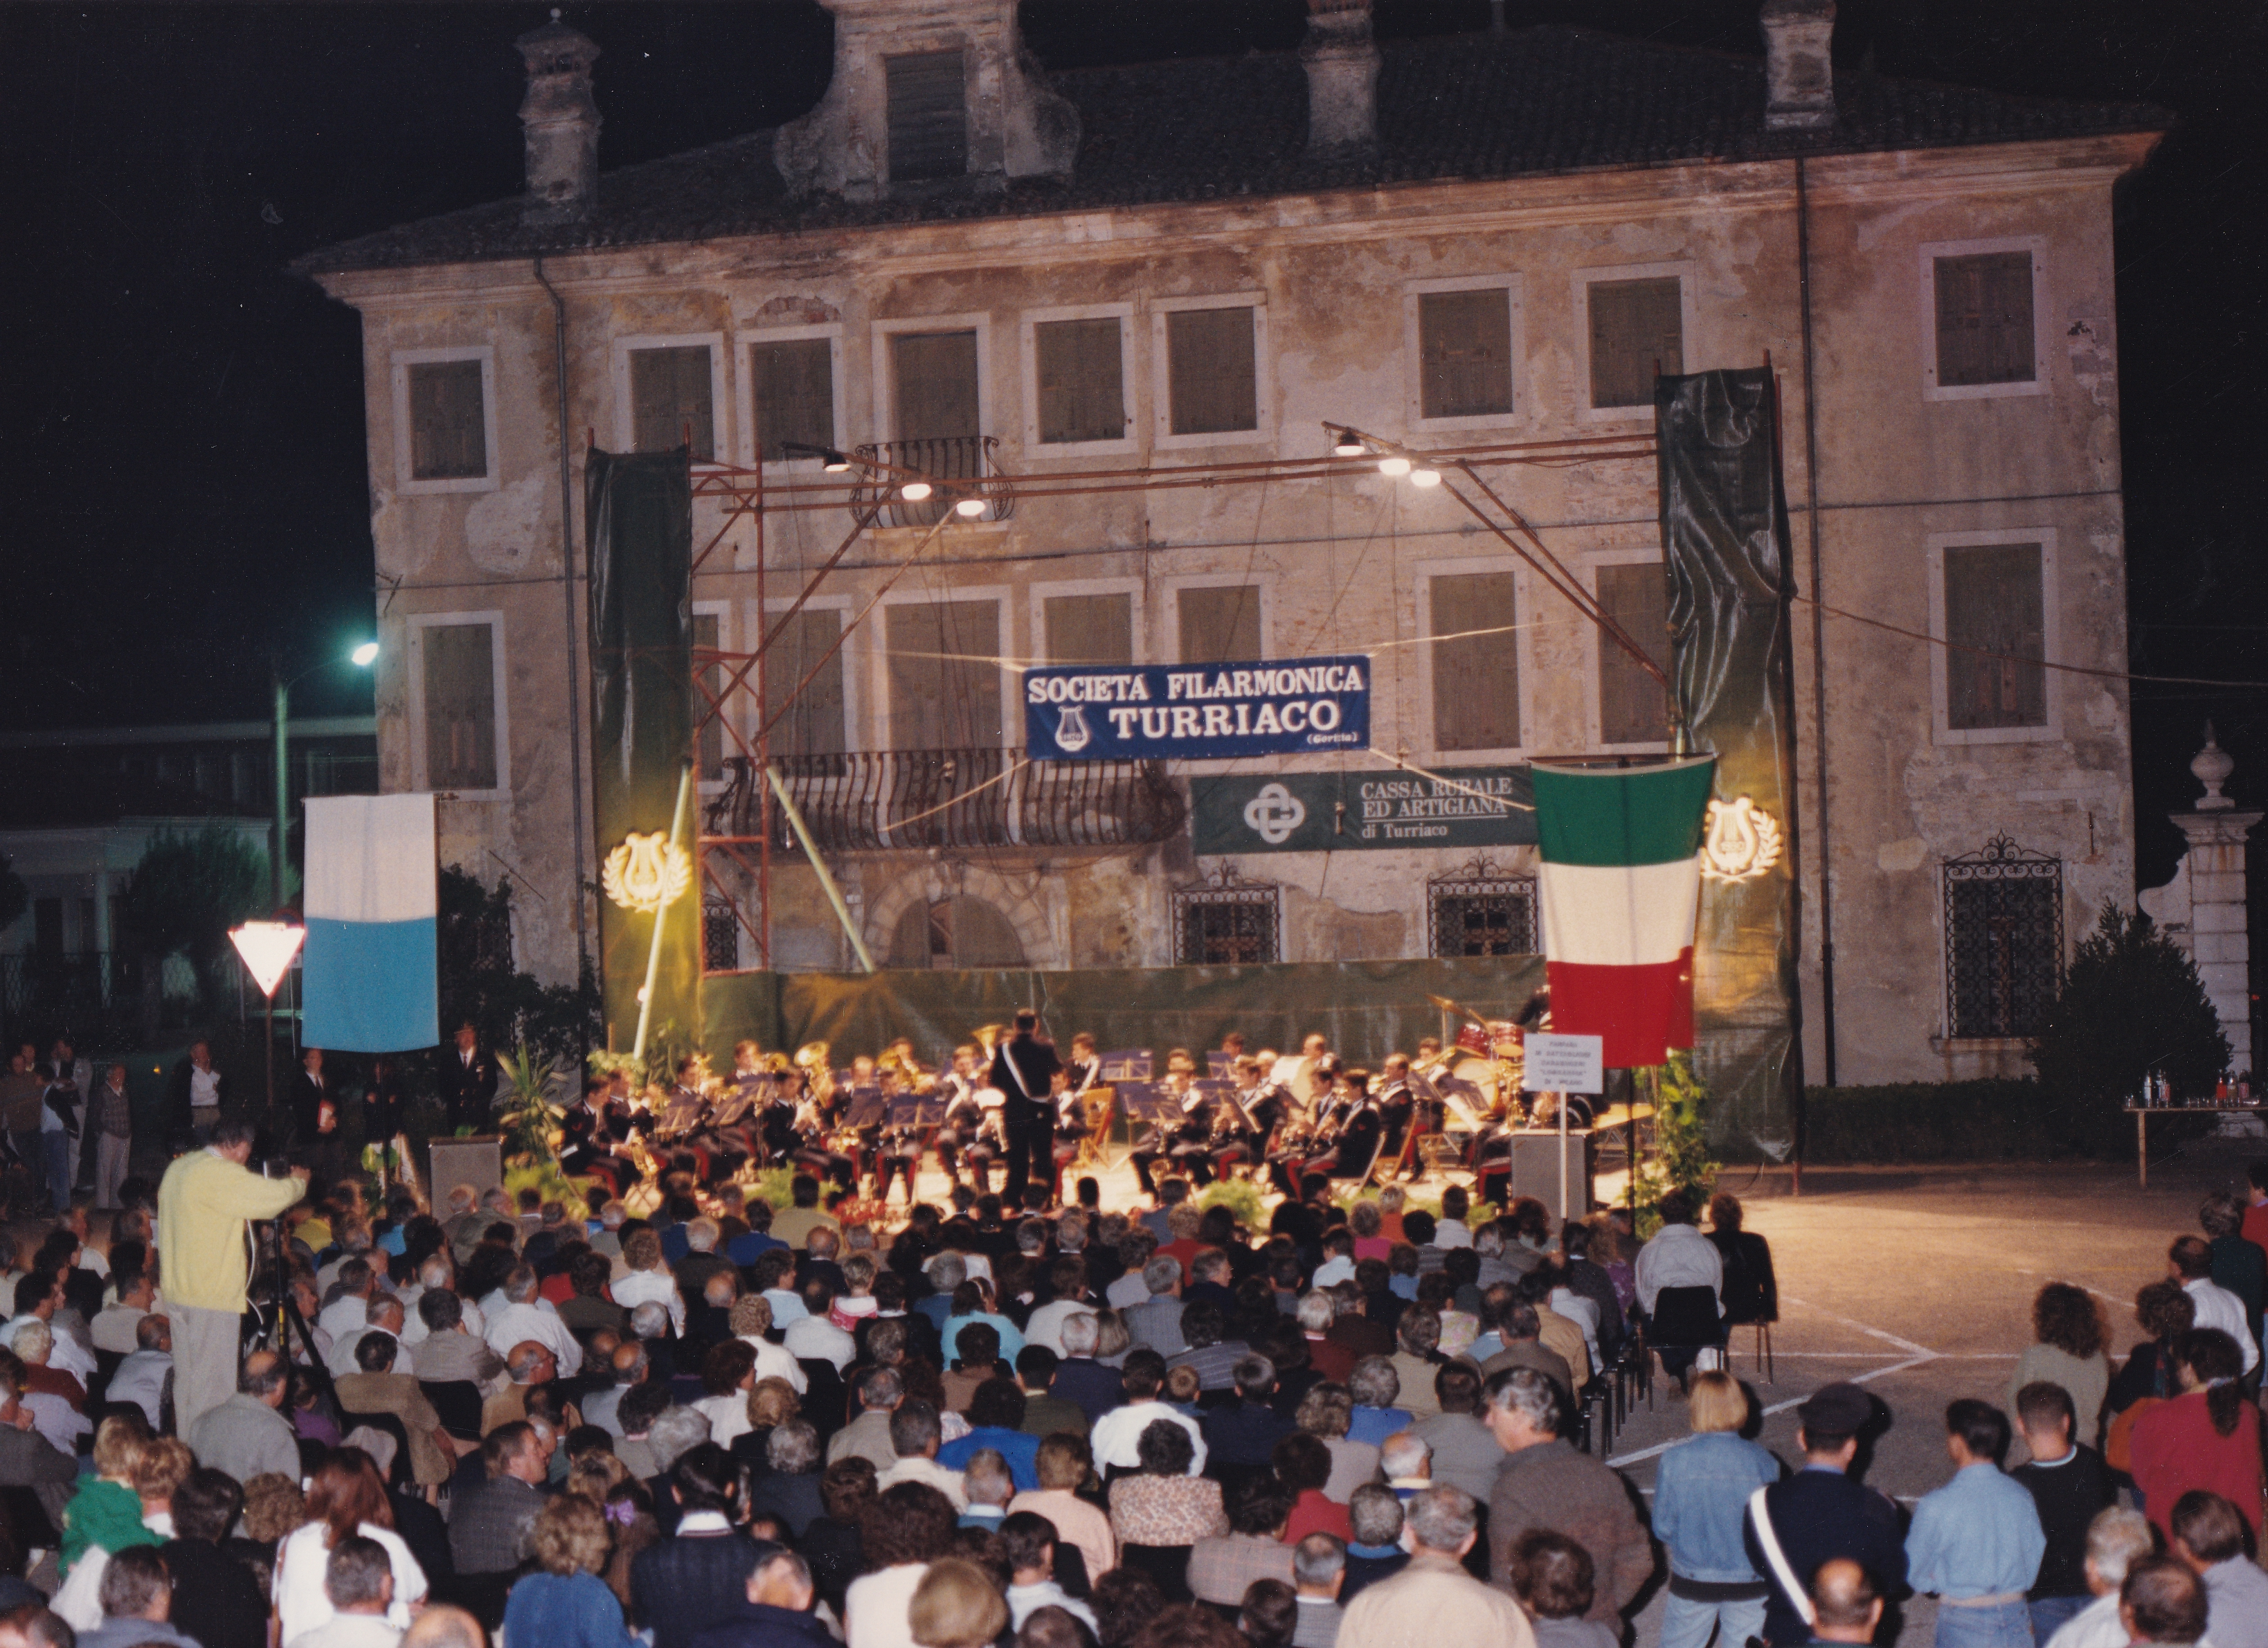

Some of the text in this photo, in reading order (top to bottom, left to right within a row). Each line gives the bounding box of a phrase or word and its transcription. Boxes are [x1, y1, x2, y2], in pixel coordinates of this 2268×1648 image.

[1167, 665, 1363, 699] FILARMONICA
[1109, 699, 1340, 739] TURRIACO
[1306, 732, 1358, 744] (Gorizia)
[1361, 778, 1512, 799] CASSA RURALE
[1362, 796, 1508, 818] ED ARTIGIANA
[1361, 823, 1448, 839] di Turriaco
